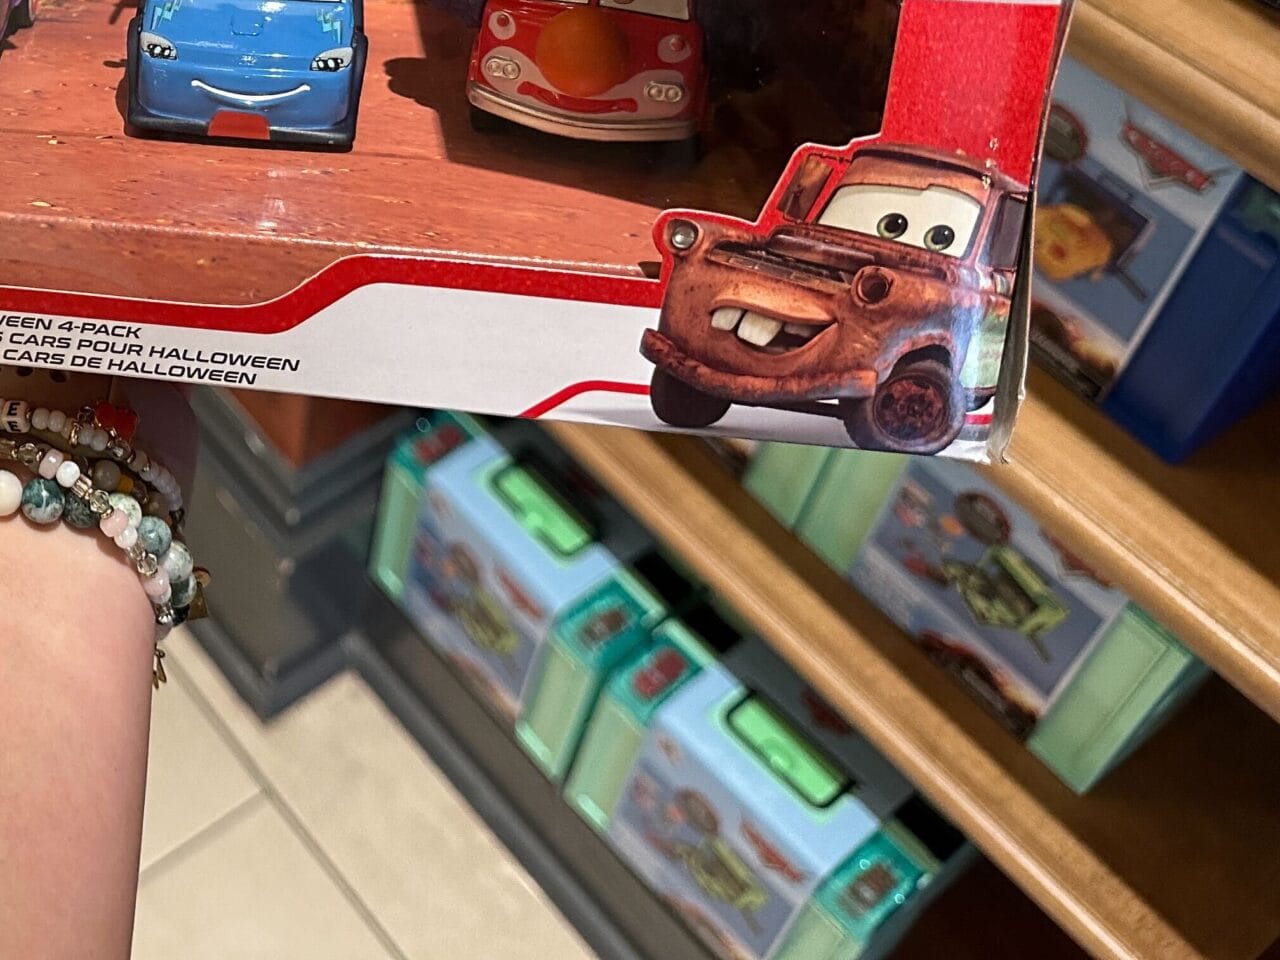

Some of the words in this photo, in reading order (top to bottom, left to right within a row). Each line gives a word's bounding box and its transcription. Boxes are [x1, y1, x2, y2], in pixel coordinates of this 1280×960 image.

[57, 320, 143, 339] 4-PACK
[2, 349, 65, 365] CARS
[70, 355, 102, 369] DE
[107, 359, 257, 385] HALLOWEEN
[9, 332, 71, 349] CARS
[77, 339, 144, 357] POUR
[149, 345, 301, 372] HALLOWEEN
